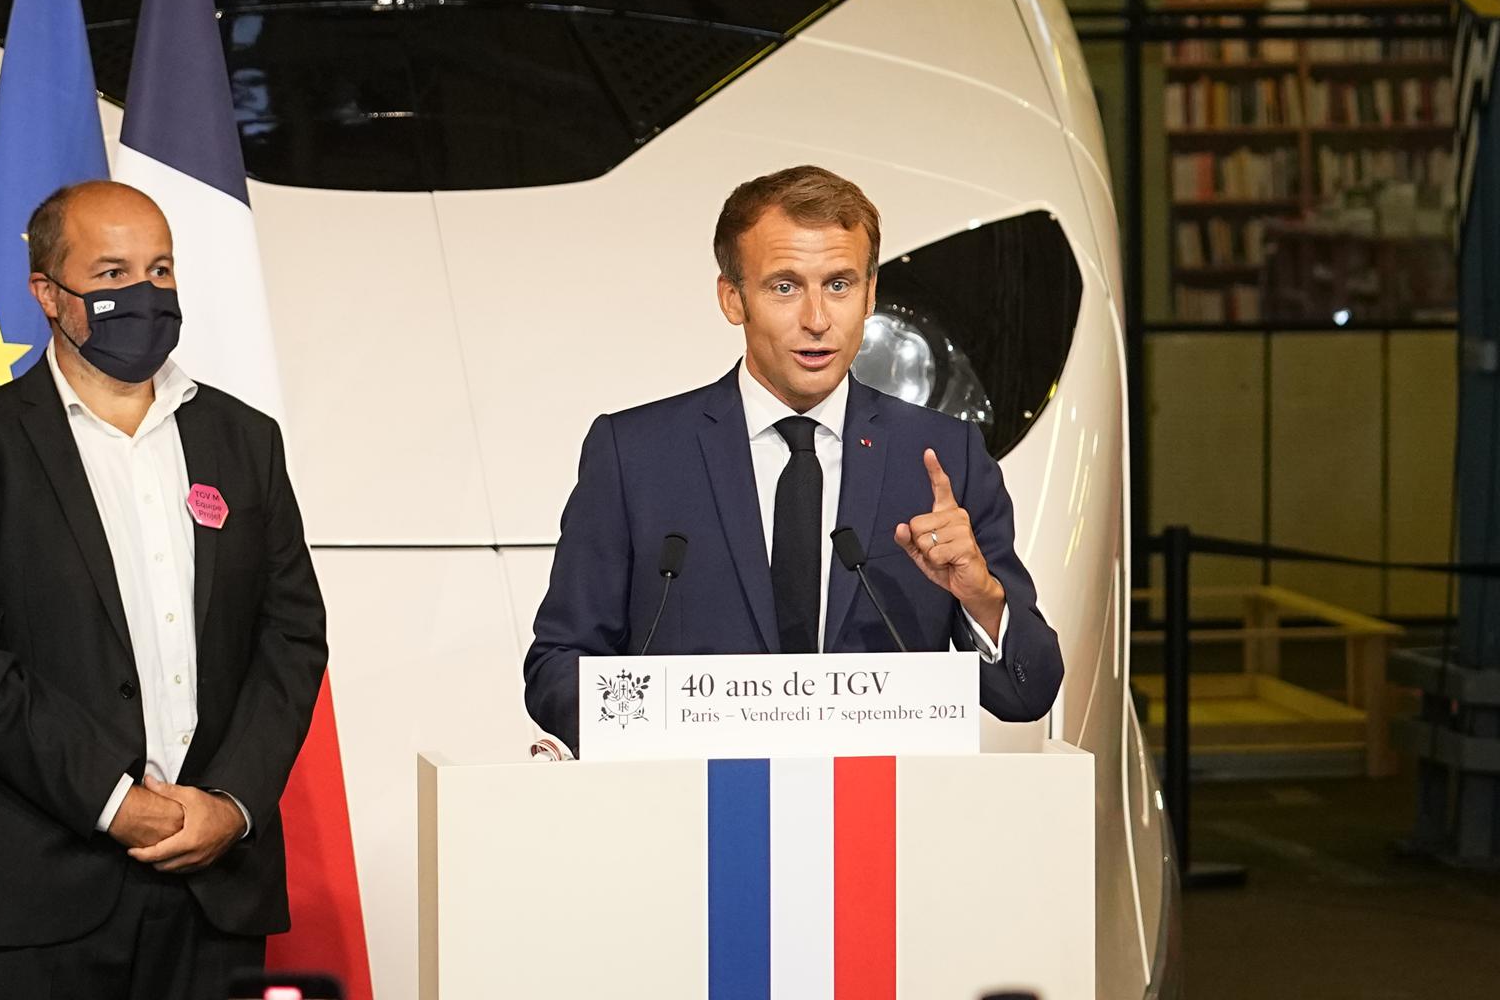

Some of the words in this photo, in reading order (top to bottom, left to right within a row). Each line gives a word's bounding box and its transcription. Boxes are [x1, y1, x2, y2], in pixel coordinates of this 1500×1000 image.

[681, 673, 715, 698] 40
[725, 678, 773, 697] ans
[783, 671, 816, 697] de
[825, 671, 890, 696] TGV
[680, 708, 720, 723] Paris
[740, 706, 811, 722] Vendredi
[818, 706, 836, 721] 17
[841, 705, 924, 725] septembre
[928, 704, 967, 719] 2021
